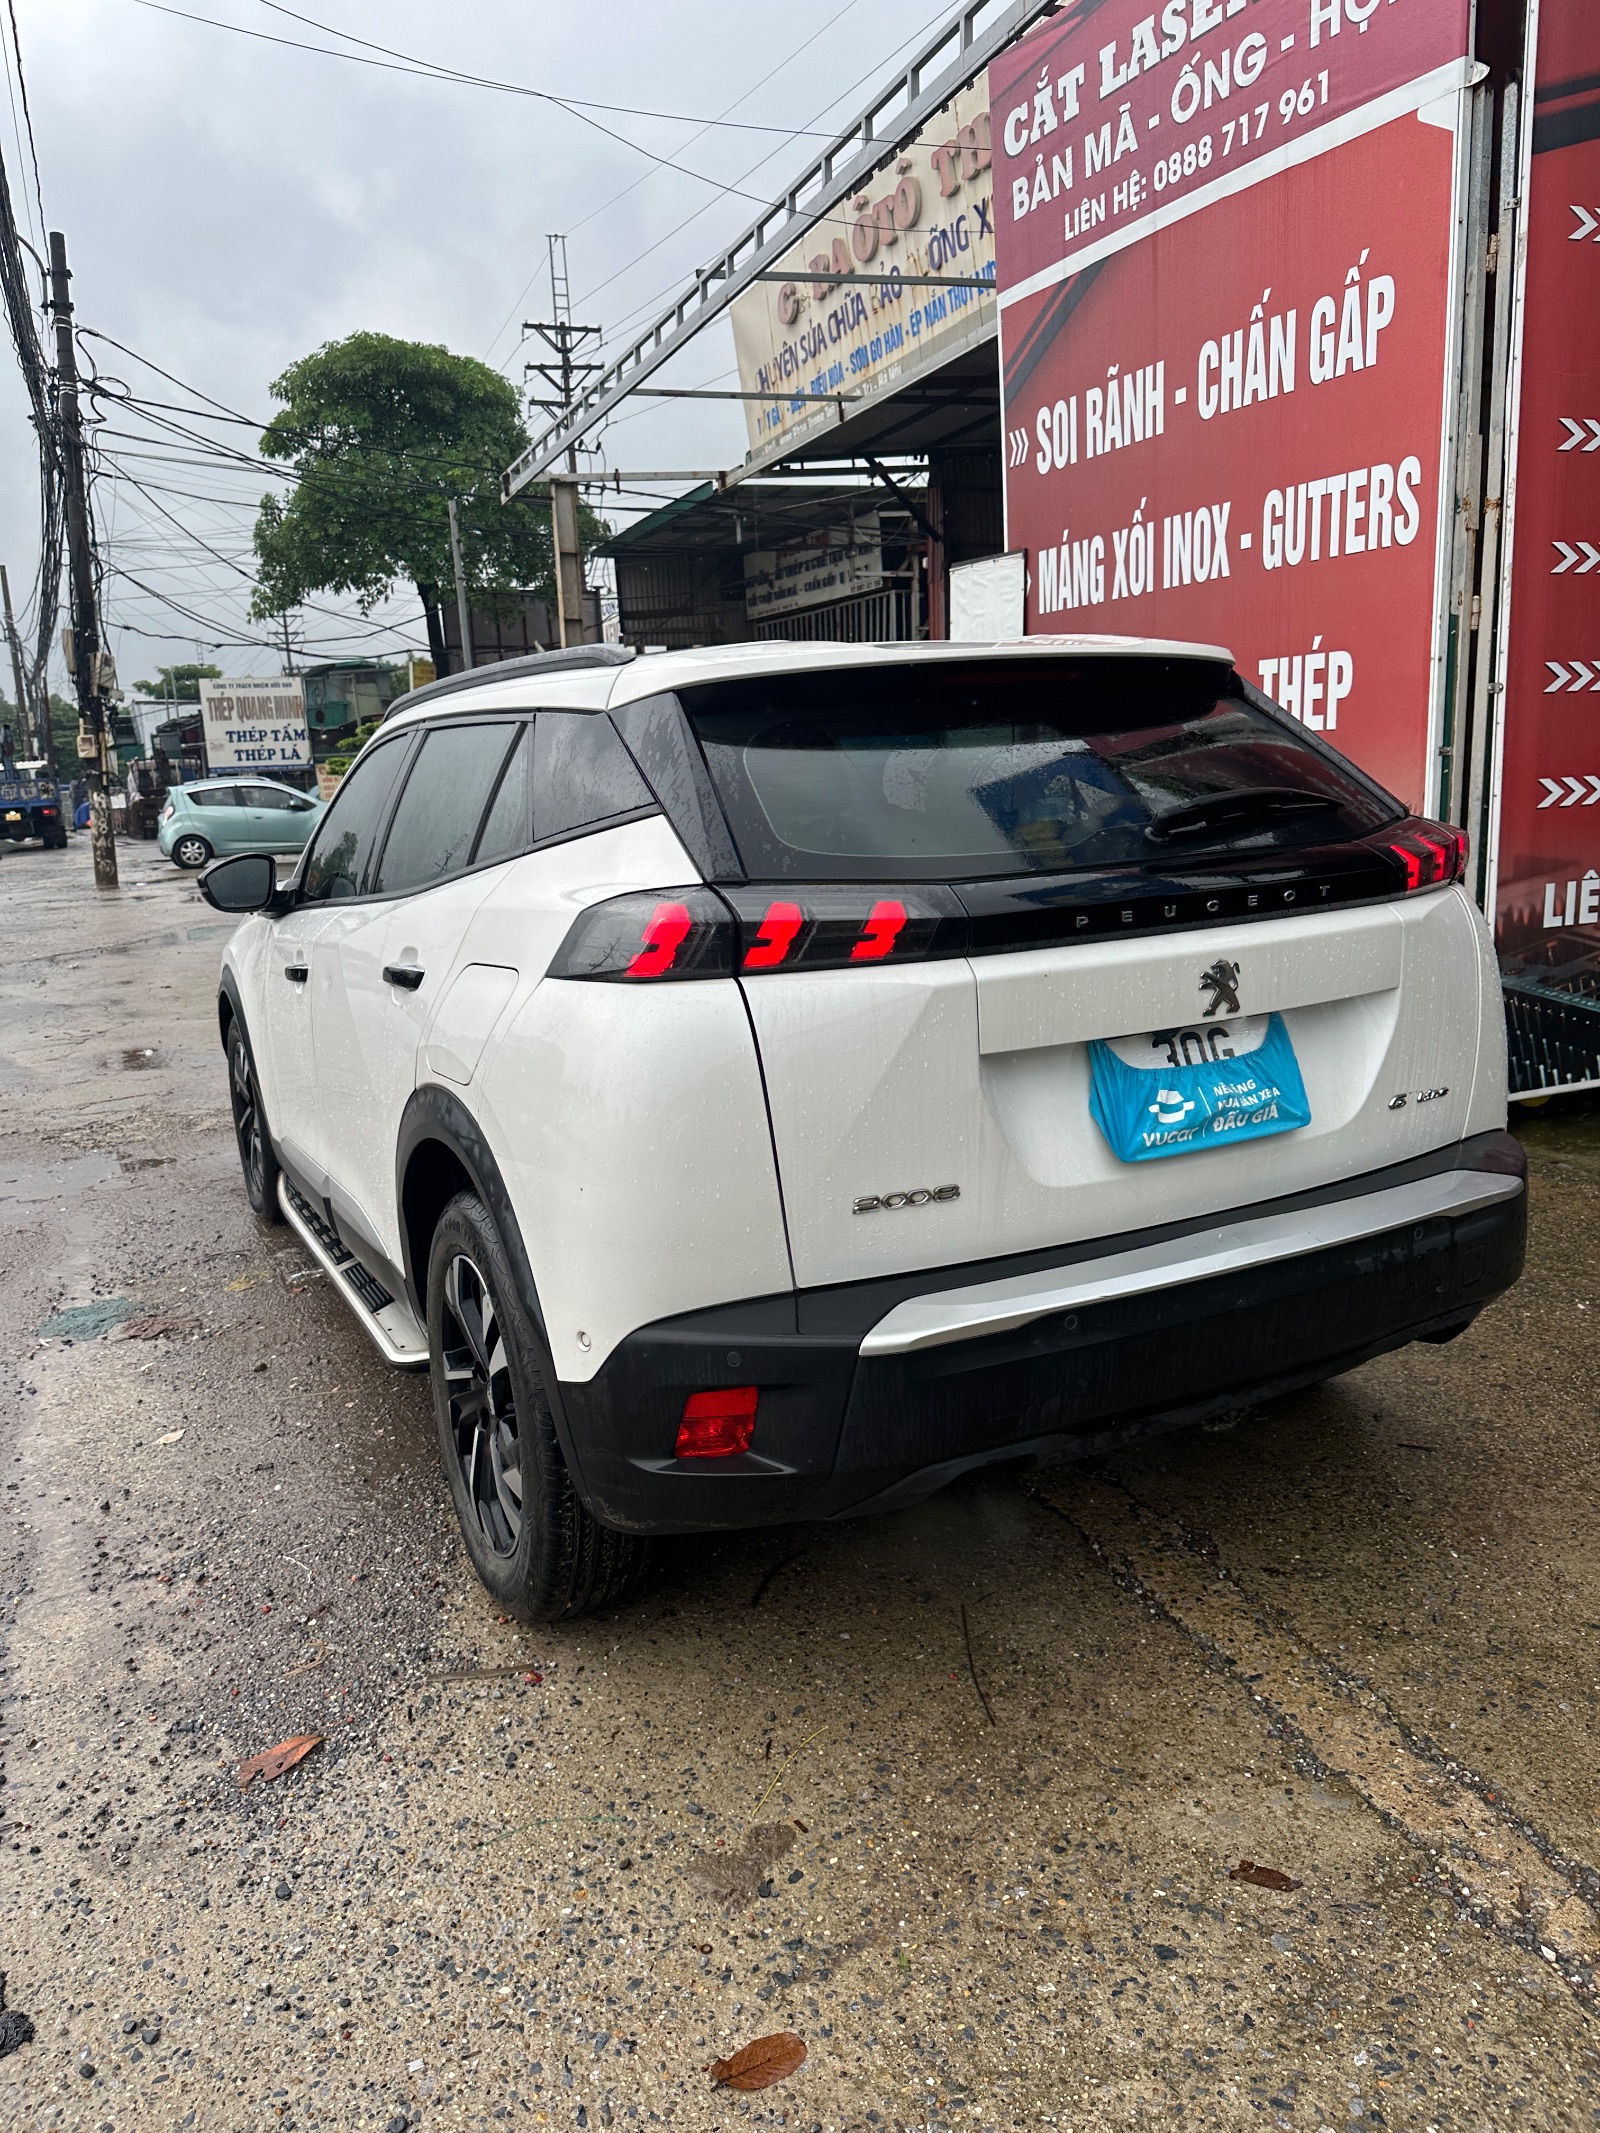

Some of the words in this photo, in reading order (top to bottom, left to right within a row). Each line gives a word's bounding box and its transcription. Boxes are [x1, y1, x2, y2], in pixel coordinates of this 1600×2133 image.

[1003, 64, 1085, 159] CẮT
[1012, 145, 1074, 222] BẢN
[1085, 102, 1139, 178] MÃ
[1171, 32, 1268, 126] ỐNG
[1064, 190, 1107, 241] LIÊN
[1113, 170, 1148, 215] HỆ:
[1153, 135, 1213, 192] 0888
[1221, 101, 1270, 157] 717
[1278, 69, 1330, 126] 961
[1036, 394, 1077, 476] SOI
[1086, 360, 1165, 460] RÃNH
[1197, 287, 1297, 421] CHẤN
[1309, 248, 1396, 386] GẤP
[1038, 529, 1105, 616] MÁNG
[1111, 496, 1155, 600] XỐI
[1163, 501, 1231, 590] INOX
[1262, 455, 1422, 572] GUTTERS
[206, 691, 235, 722] THÉP
[235, 696, 273, 724] QUANG
[1258, 635, 1354, 732] THÉP
[225, 726, 268, 743] THÉP
[270, 723, 306, 742] TẤM
[234, 744, 276, 761] THÉP
[280, 743, 302, 761] LÁ
[1075, 885, 1331, 928] PEUGEOT
[1213, 1109, 1250, 1132] ĐẤU
[1251, 1100, 1279, 1124] GIÁ
[852, 1183, 961, 1215] 2008
